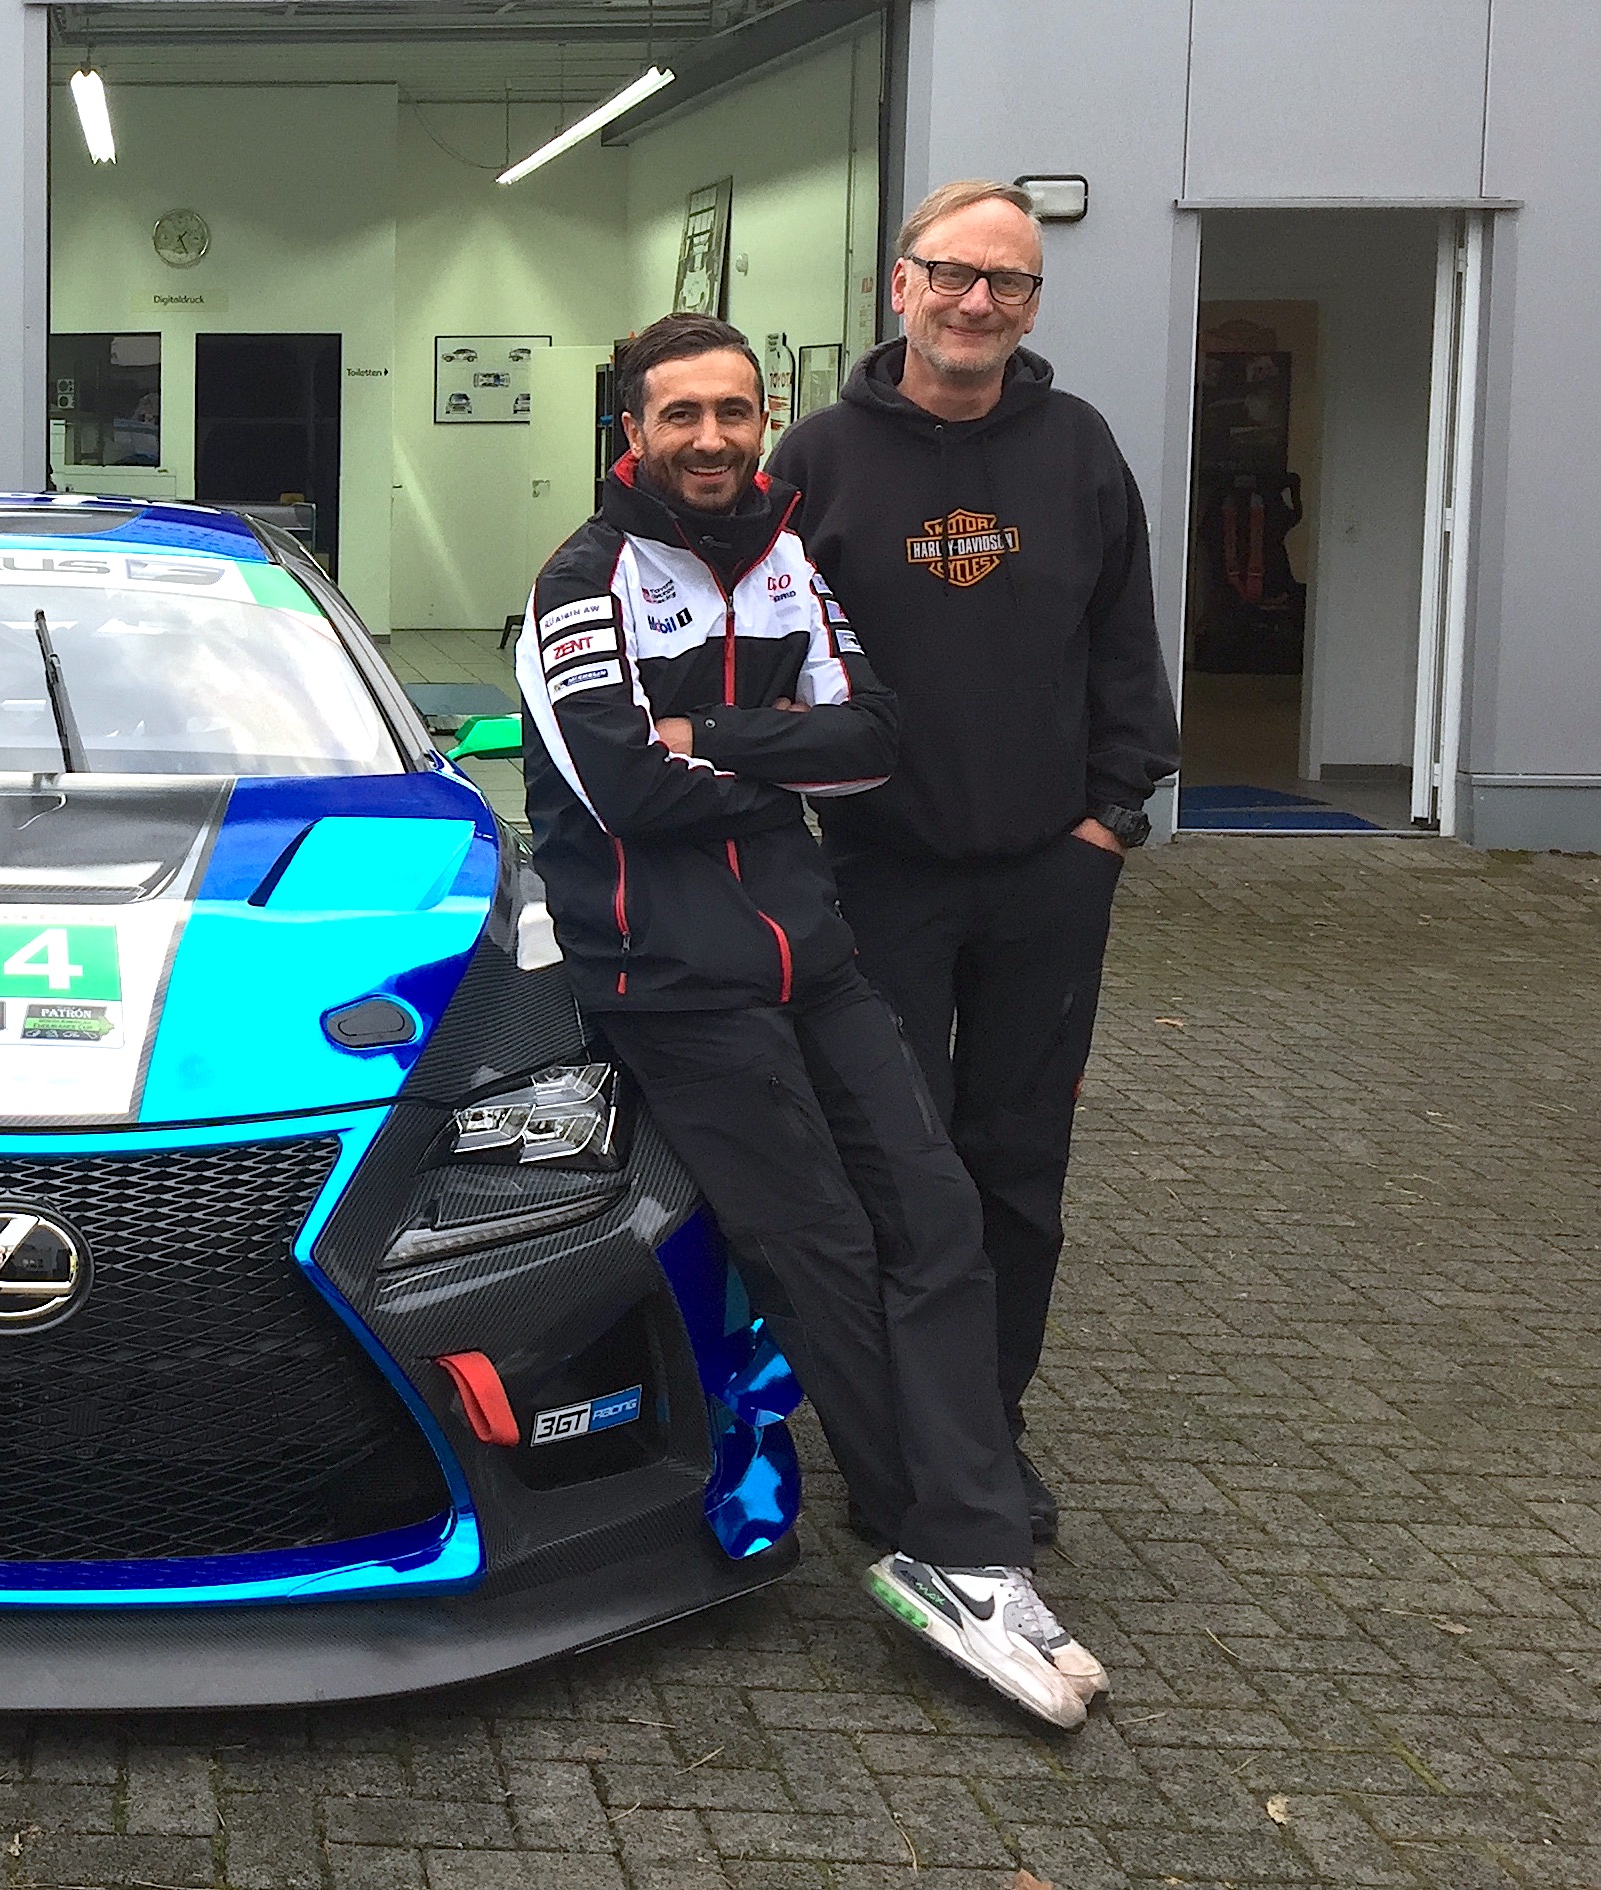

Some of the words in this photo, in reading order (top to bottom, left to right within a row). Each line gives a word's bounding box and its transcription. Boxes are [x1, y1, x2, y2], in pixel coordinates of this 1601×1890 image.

[153, 294, 205, 307] Digitaldruck
[346, 367, 383, 377] Toiletten
[553, 636, 594, 660] ZENT
[536, 1408, 591, 1440] 3GT
